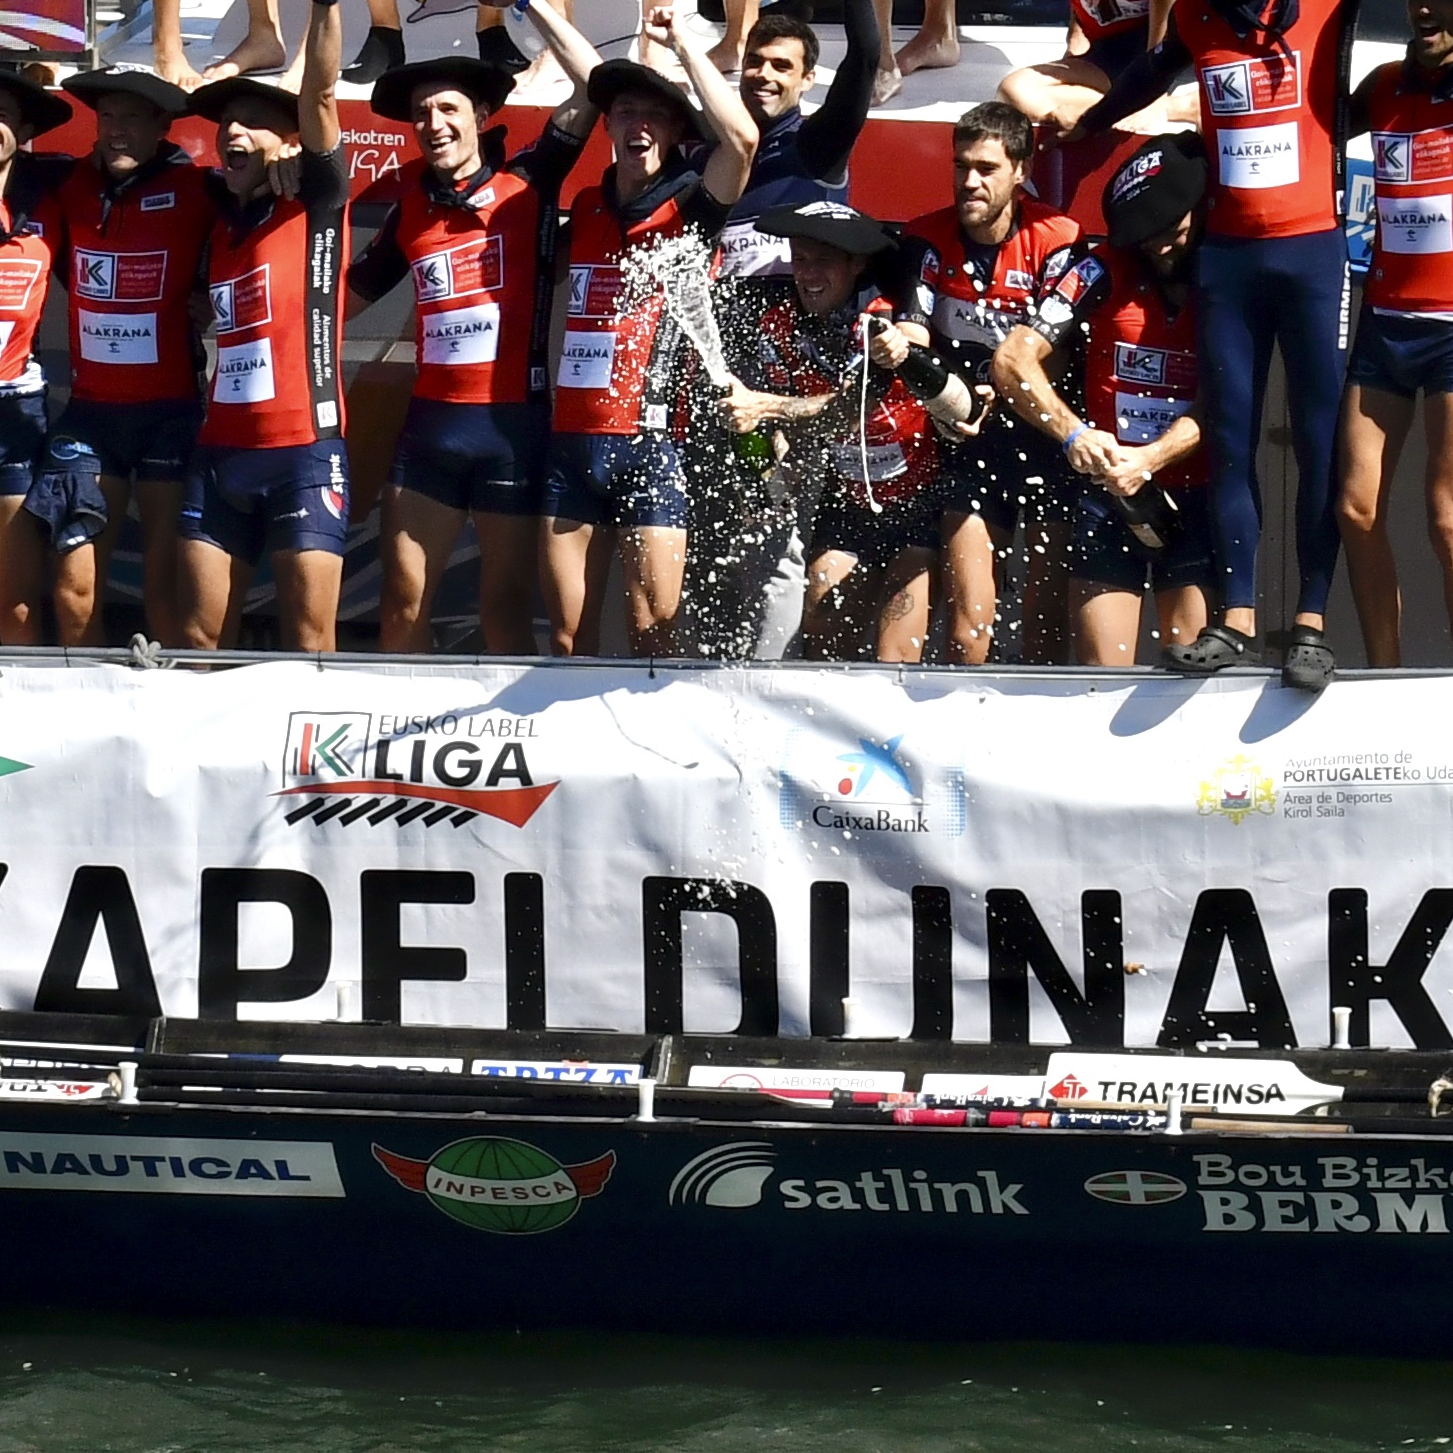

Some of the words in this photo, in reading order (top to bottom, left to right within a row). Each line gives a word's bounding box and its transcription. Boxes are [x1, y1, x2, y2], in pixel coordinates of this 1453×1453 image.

[339, 129, 406, 147] skotren
[1222, 142, 1292, 156] ALAKRANA
[1381, 213, 1447, 225] ALAKRANA
[311, 232, 323, 288] elikagaiak
[323, 228, 335, 294] Goi-mailako
[82, 326, 151, 338] ALAKRANA
[312, 308, 321, 345] calidad
[313, 347, 324, 388] superior
[378, 713, 459, 741] EUSKO
[467, 714, 540, 740] LABEL
[374, 740, 535, 789] LIGA
[1285, 751, 1389, 769] Ayuntamiento
[1394, 750, 1413, 765] de
[1283, 765, 1422, 783] PORTUGALETEko
[1283, 789, 1314, 805] Área
[1316, 791, 1333, 805] de
[1336, 790, 1394, 808] Deportes
[812, 804, 931, 835] CaixaBank
[1283, 805, 1313, 820] Kirol
[1316, 804, 1346, 818] Saila
[773, 1076, 875, 1090] LABORATORIO
[1098, 1080, 1287, 1106] TRAMEINSA
[3, 1149, 311, 1183] NAUTICAL
[1192, 1153, 1307, 1188] Bou
[433, 1176, 575, 1201] INPESCA
[778, 1168, 1031, 1216] satlink
